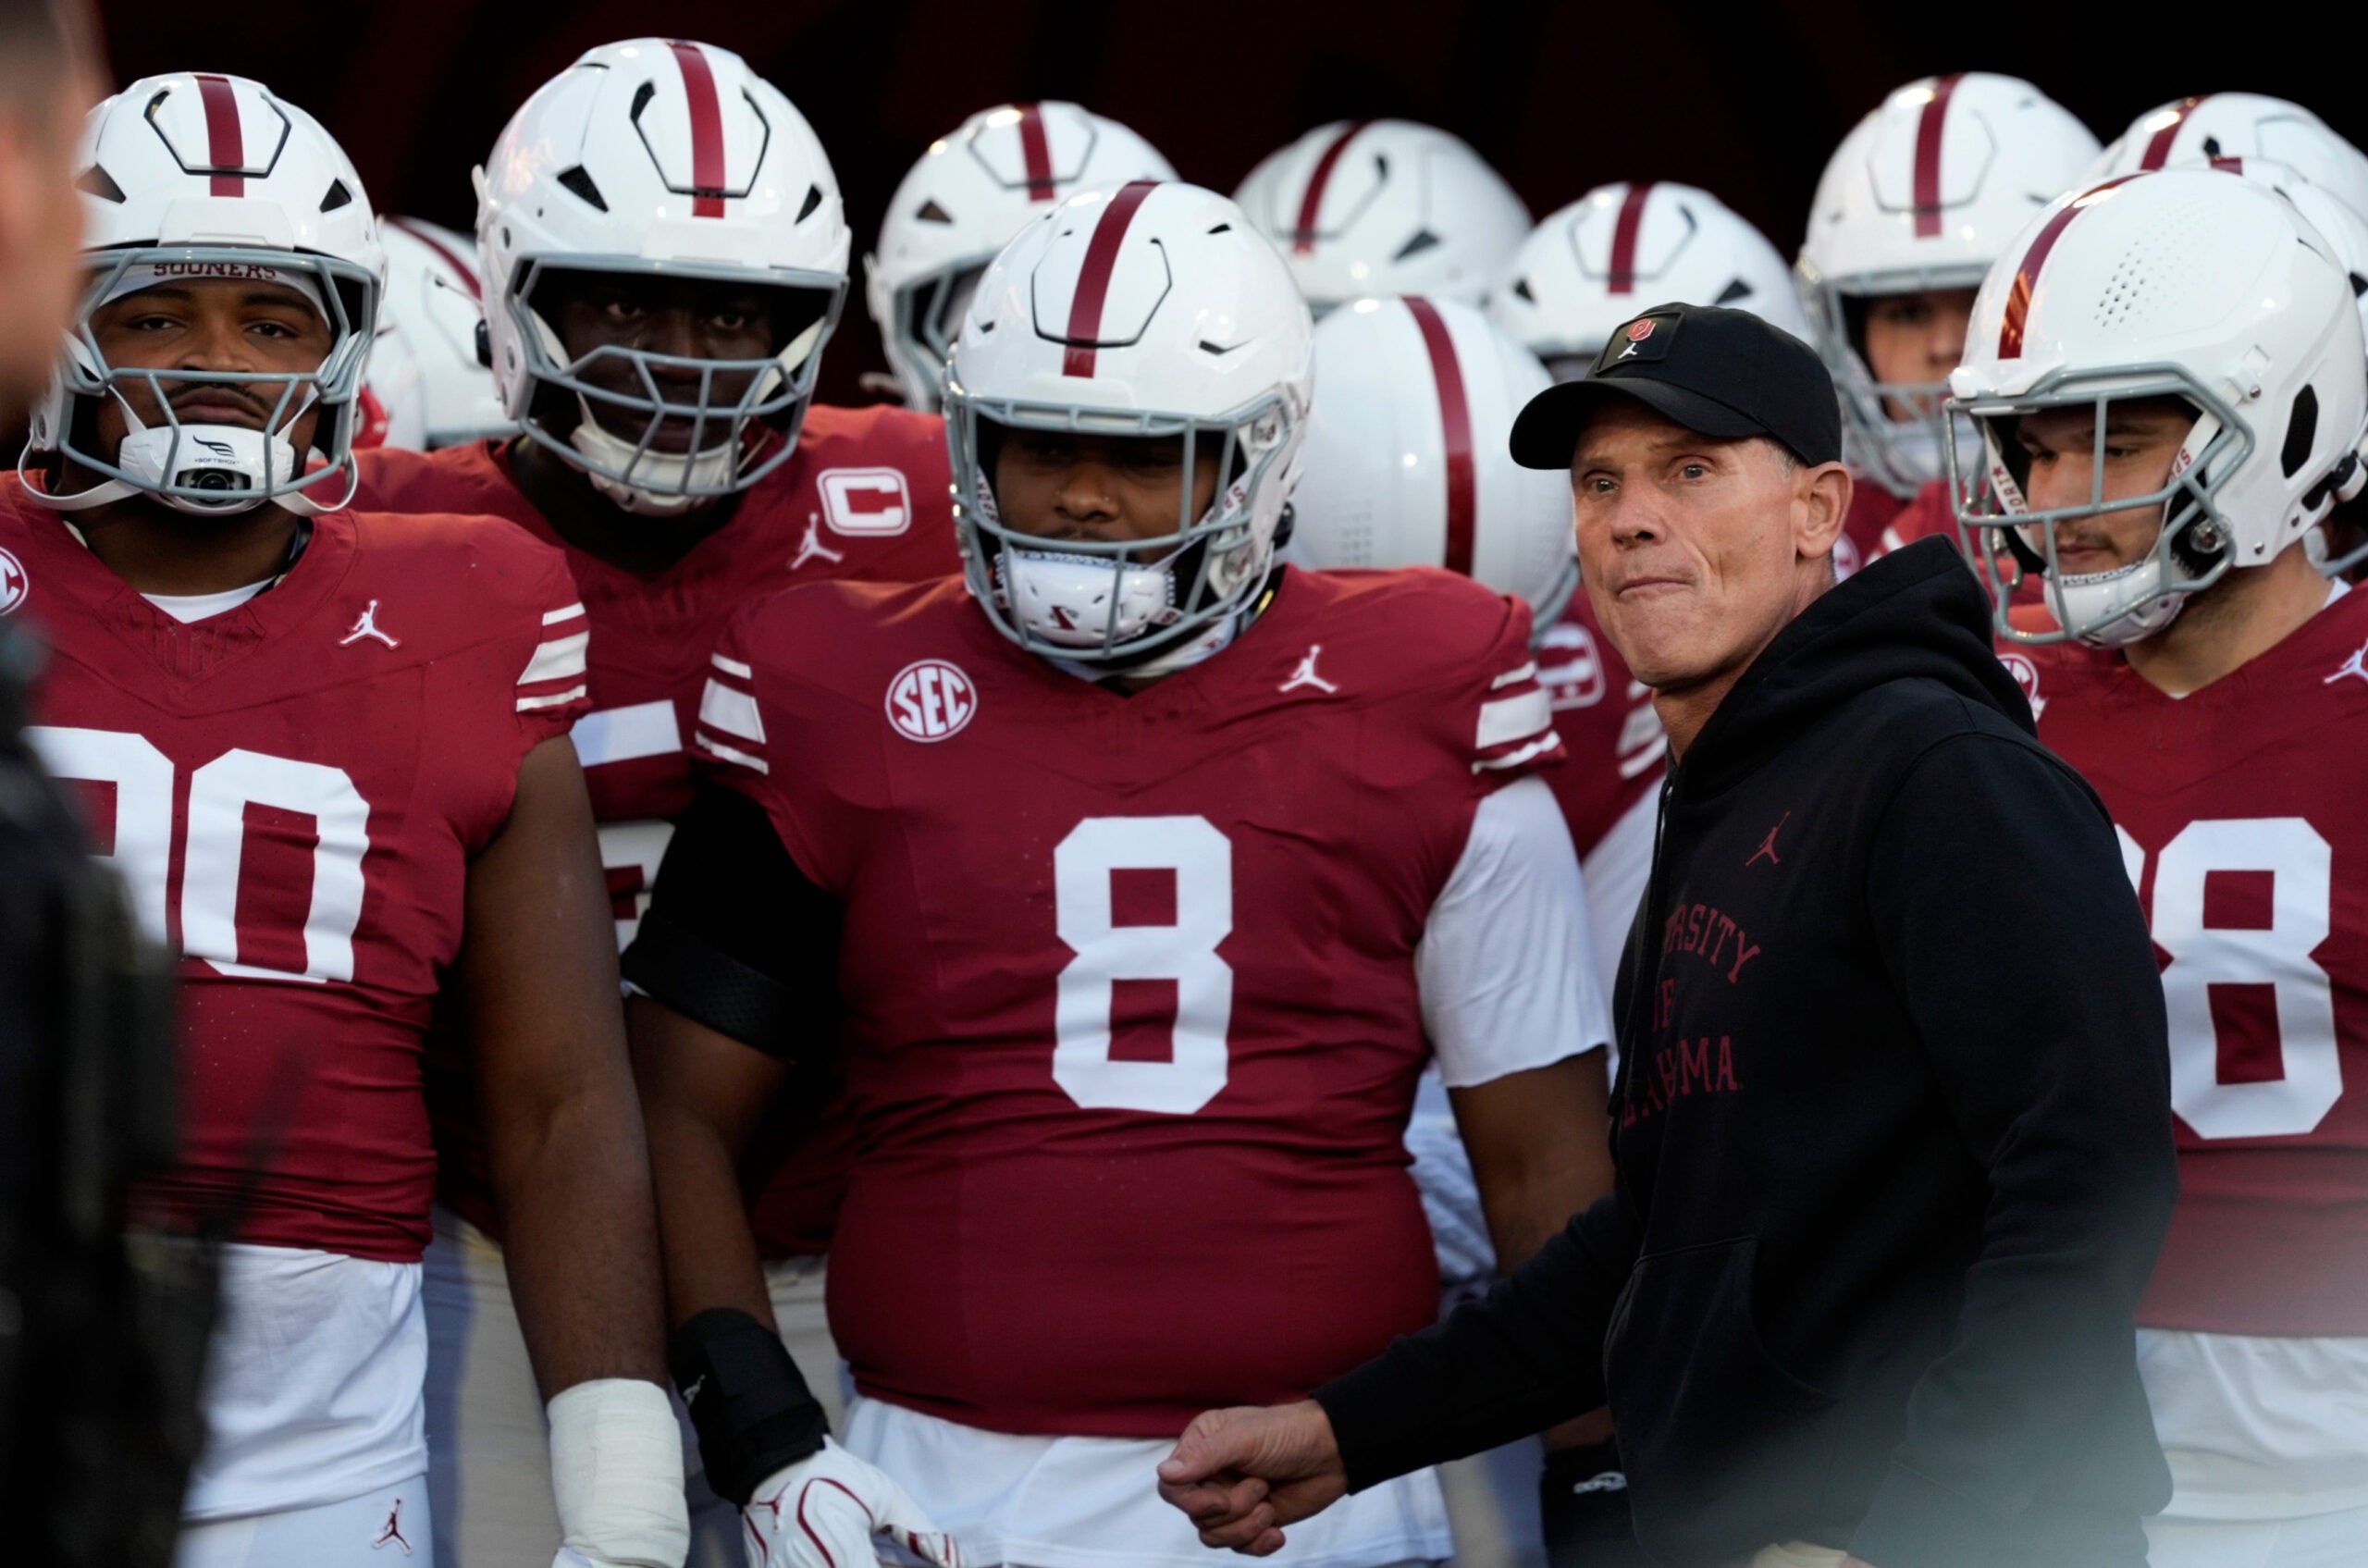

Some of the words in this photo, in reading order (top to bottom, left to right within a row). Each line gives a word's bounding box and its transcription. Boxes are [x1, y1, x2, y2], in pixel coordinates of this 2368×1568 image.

[153, 262, 277, 279] SOONERS
[823, 474, 905, 529] C
[893, 666, 969, 737] SEC
[1052, 814, 1233, 1116] 8
[2115, 816, 2343, 1140] 8
